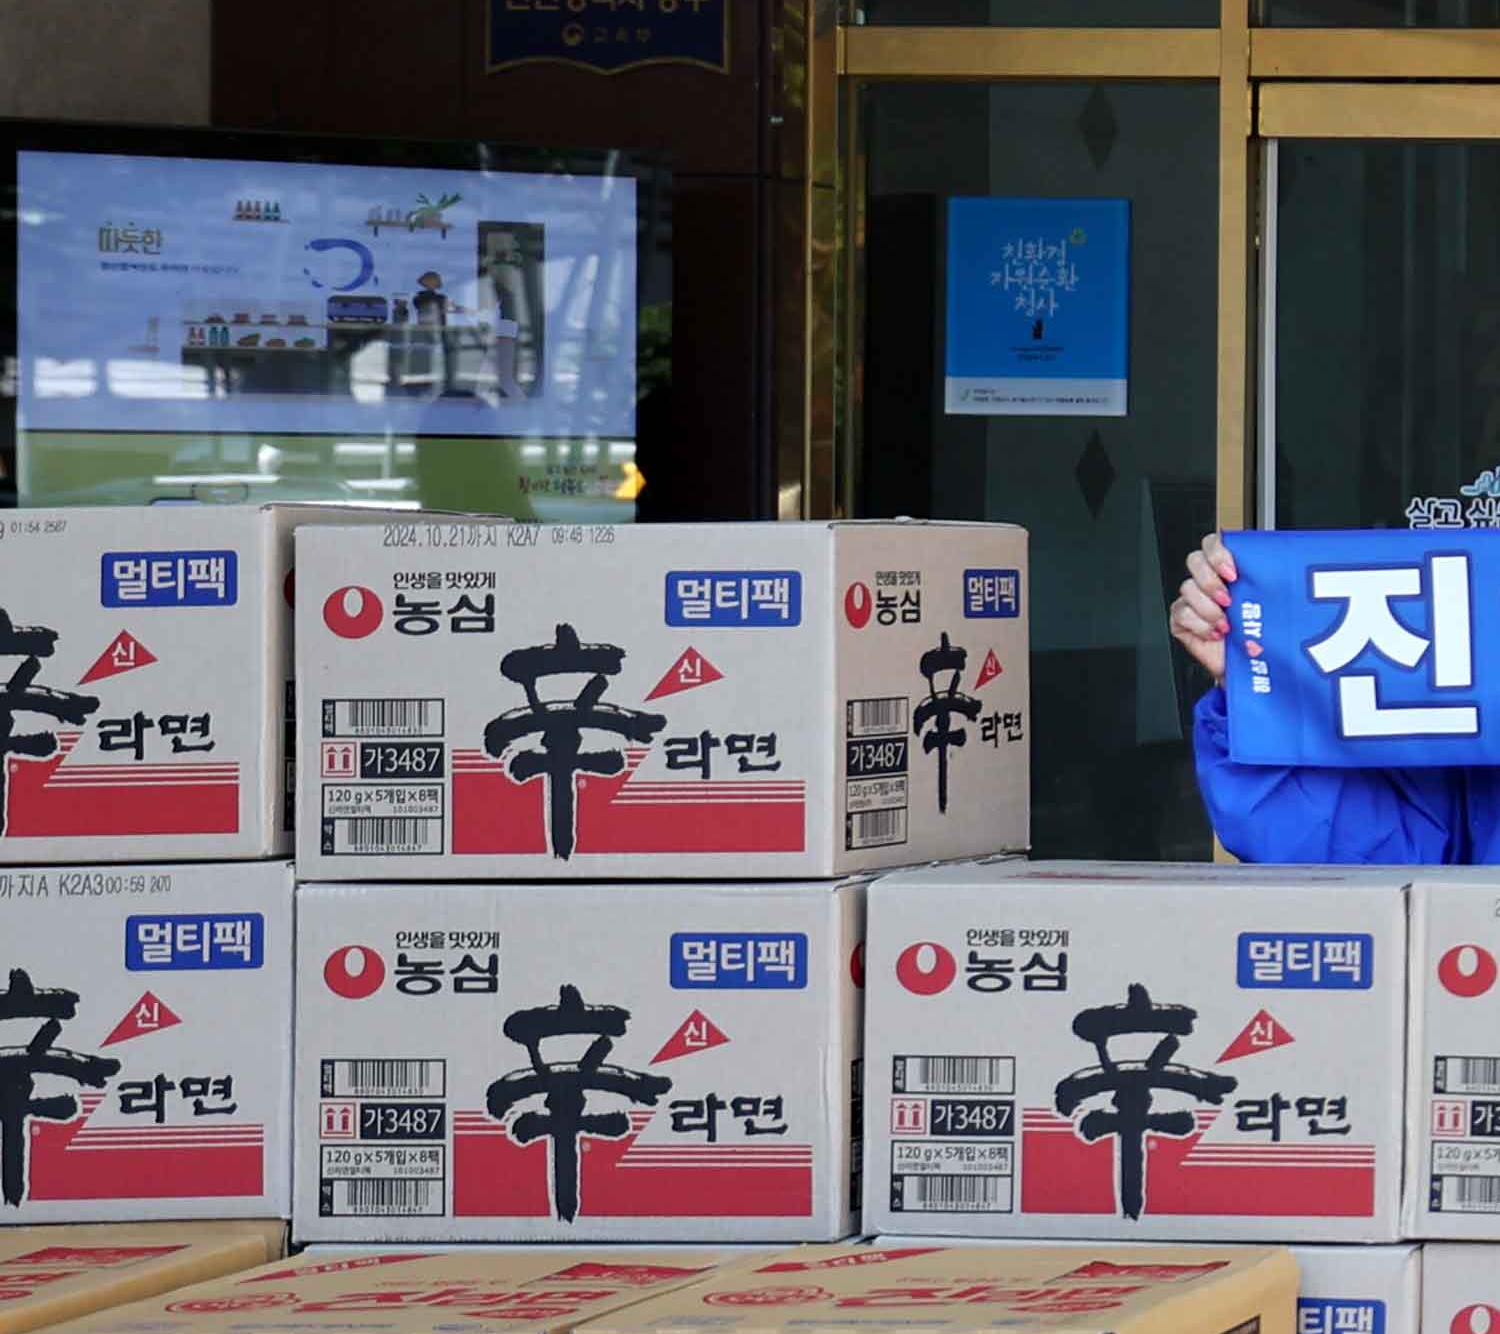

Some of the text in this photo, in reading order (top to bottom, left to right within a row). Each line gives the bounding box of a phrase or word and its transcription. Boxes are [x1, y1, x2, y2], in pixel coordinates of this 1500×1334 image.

[1001, 238, 1067, 266] 친환경
[990, 262, 1079, 291] 자원순환
[1014, 289, 1059, 317] 청사
[1406, 497, 1464, 529] 살고
[507, 526, 539, 548] K2A7
[112, 556, 227, 601] 멀티팩
[393, 572, 496, 589] 인생을 맛있게
[967, 575, 1016, 614] 멀티팩
[392, 593, 495, 635] 농심
[677, 578, 790, 620] 멀티팩
[875, 587, 922, 625] 농심
[678, 656, 702, 683] 신
[98, 713, 215, 760] 라면
[484, 623, 667, 861] 辛
[664, 729, 781, 779] 라면
[365, 747, 440, 773] 가3487
[328, 789, 351, 803] 120
[394, 951, 500, 994] 농심
[965, 950, 1069, 993] 농심
[1248, 940, 1362, 983] 멀티팩
